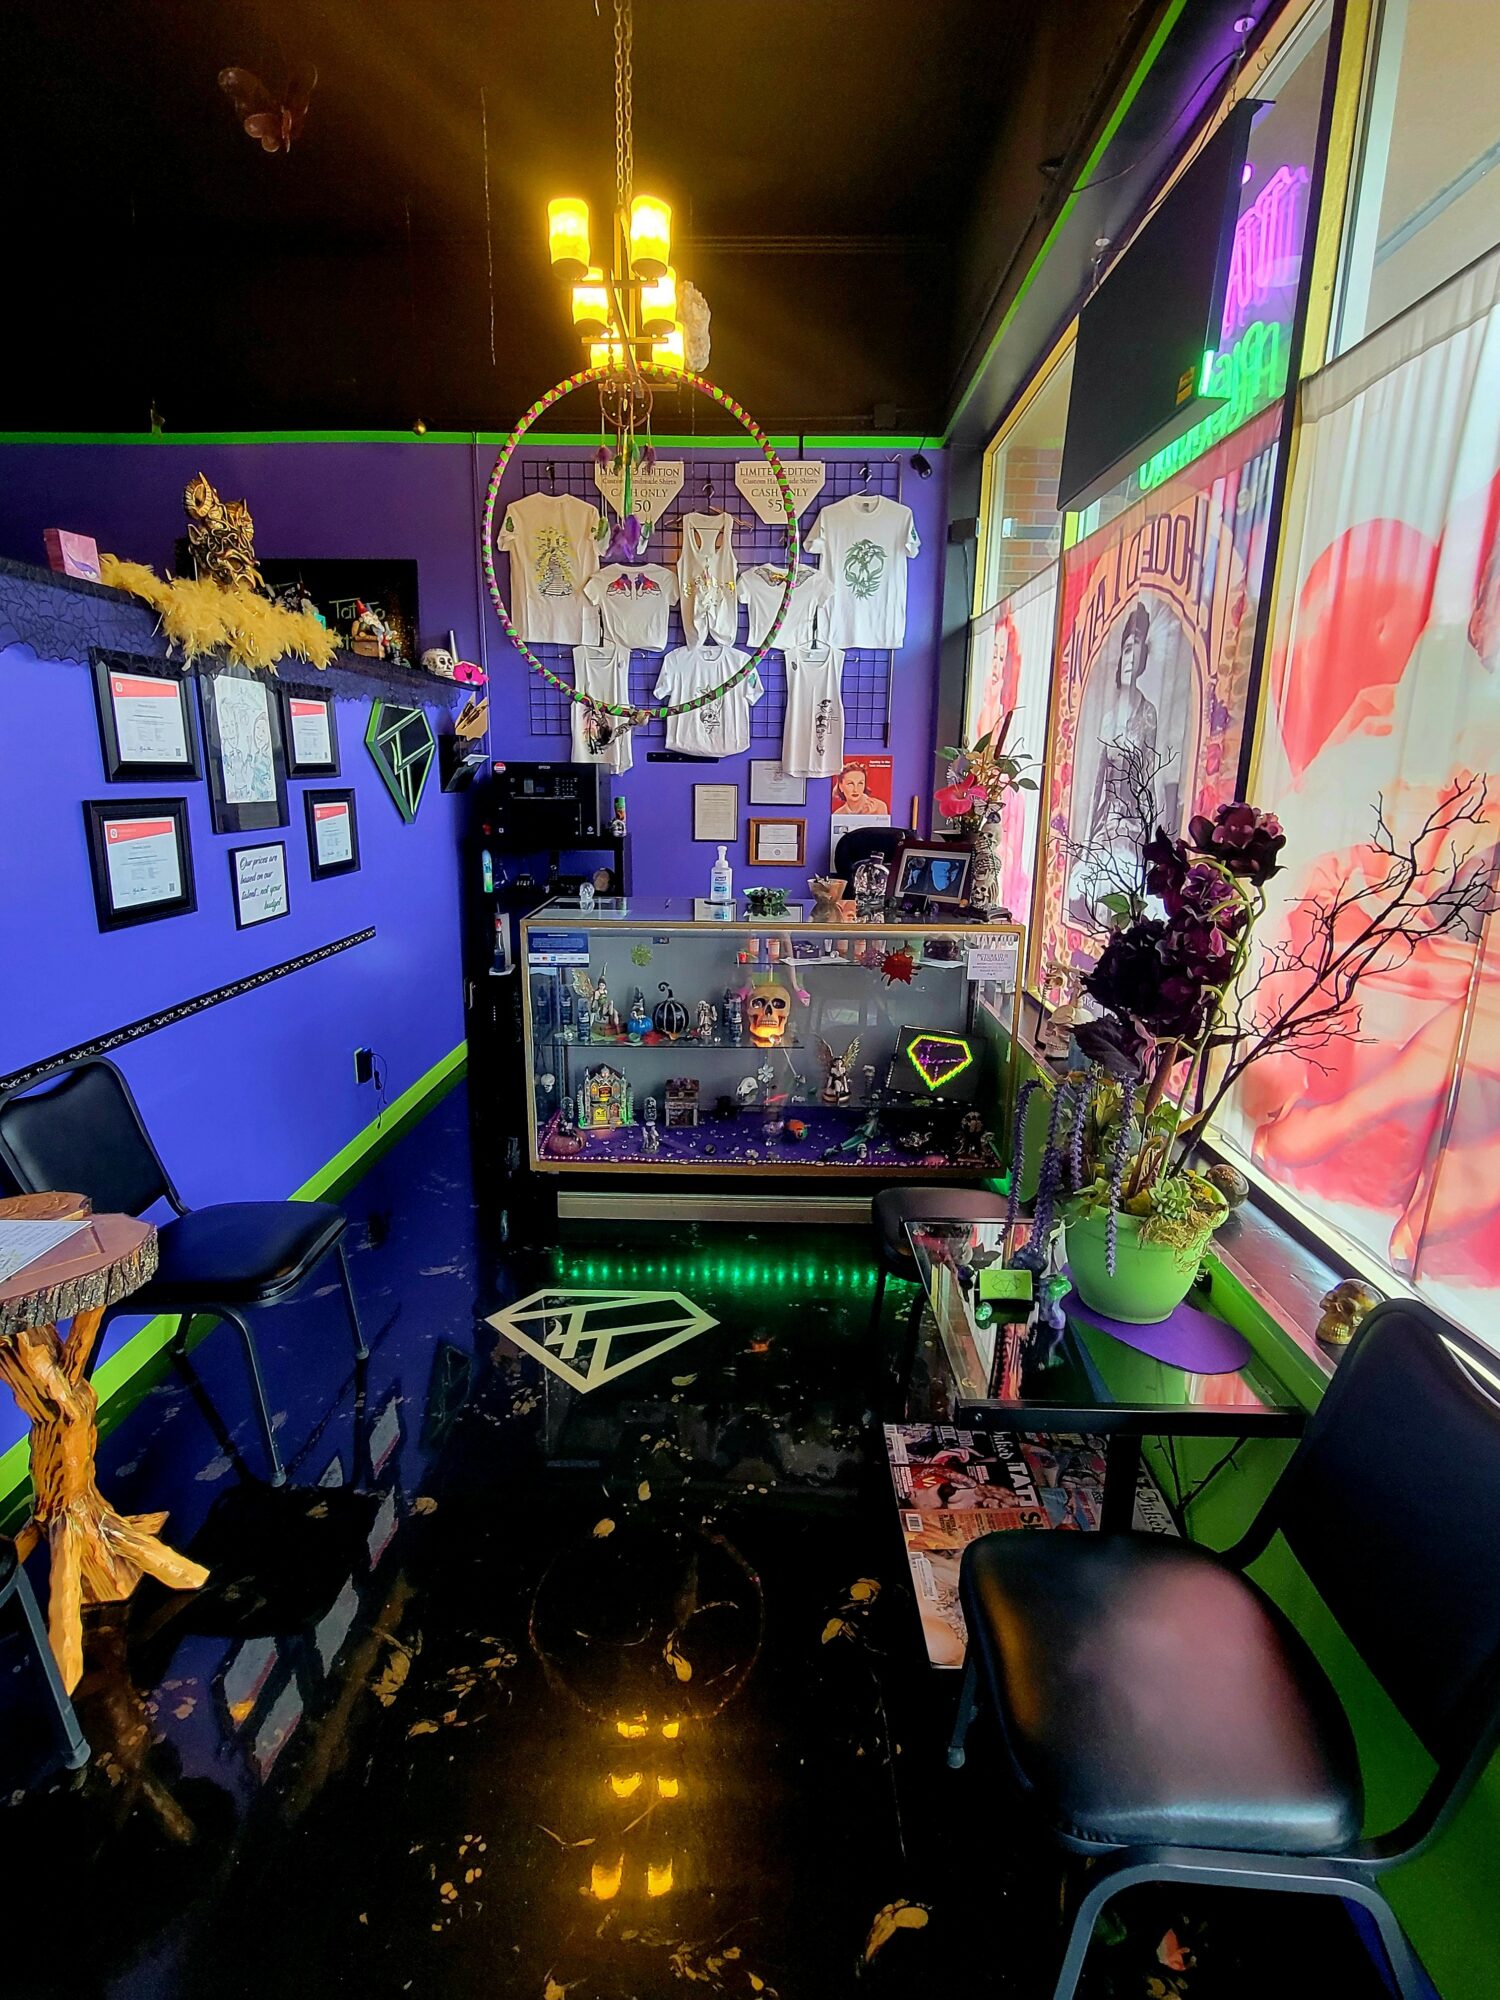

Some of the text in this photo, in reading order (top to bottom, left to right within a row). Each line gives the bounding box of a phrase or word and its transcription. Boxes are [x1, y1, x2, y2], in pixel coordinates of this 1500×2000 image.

[600, 468, 680, 476] LIMD EDITION
[740, 467, 774, 476] LIMITE
[610, 488, 668, 498] CH ONLY
[751, 488, 809, 497] CASH NLY
[634, 499, 652, 513] 50
[767, 499, 782, 513] $5
[240, 856, 252, 871] Our
[252, 856, 268, 870] prices
[240, 872, 257, 884] based
[260, 884, 270, 895] not
[270, 885, 282, 896] your
[264, 897, 282, 913] budget
[975, 934, 1015, 946] TATTOO
[1136, 1490, 1168, 1534] Inked
